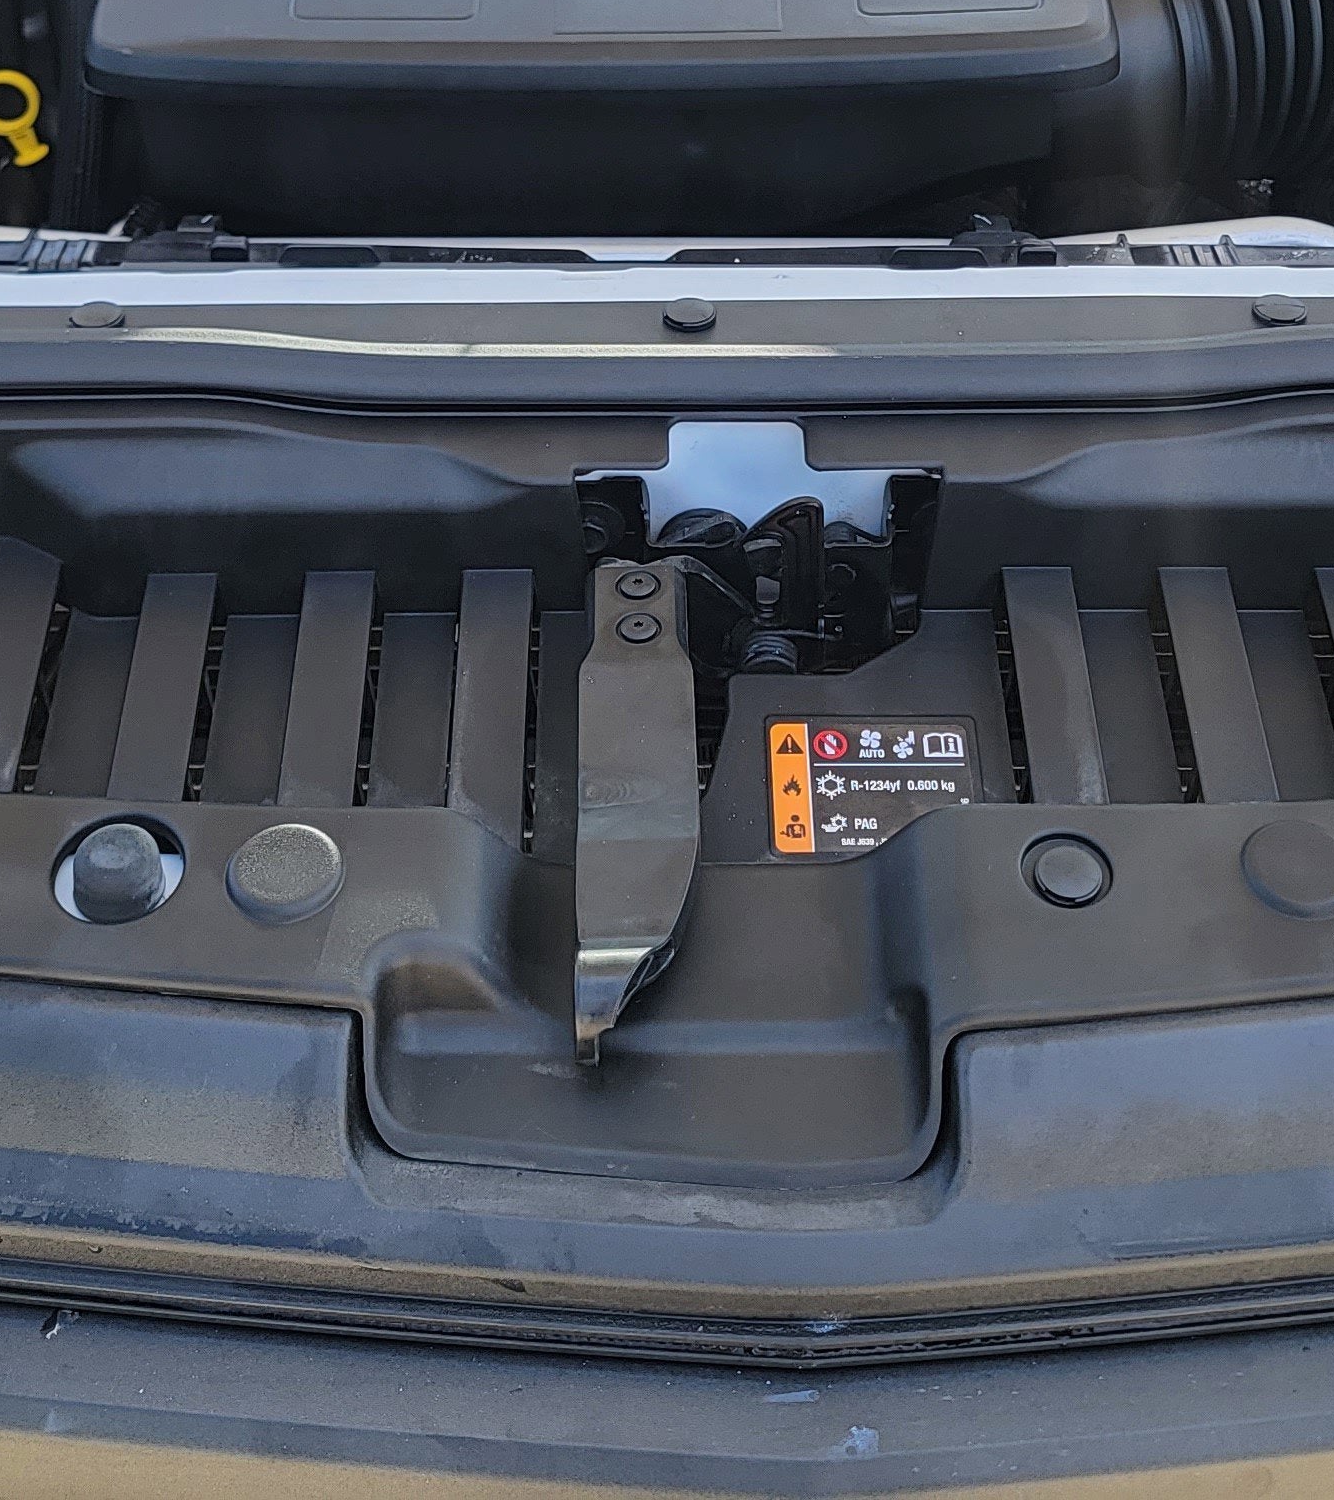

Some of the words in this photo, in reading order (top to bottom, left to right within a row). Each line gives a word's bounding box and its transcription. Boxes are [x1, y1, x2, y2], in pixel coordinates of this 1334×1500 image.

[859, 749, 885, 758] AUTO
[851, 779, 901, 792] R-1234yf
[907, 779, 938, 791] 0.600
[941, 779, 955, 792] kg
[854, 818, 878, 830] PAG
